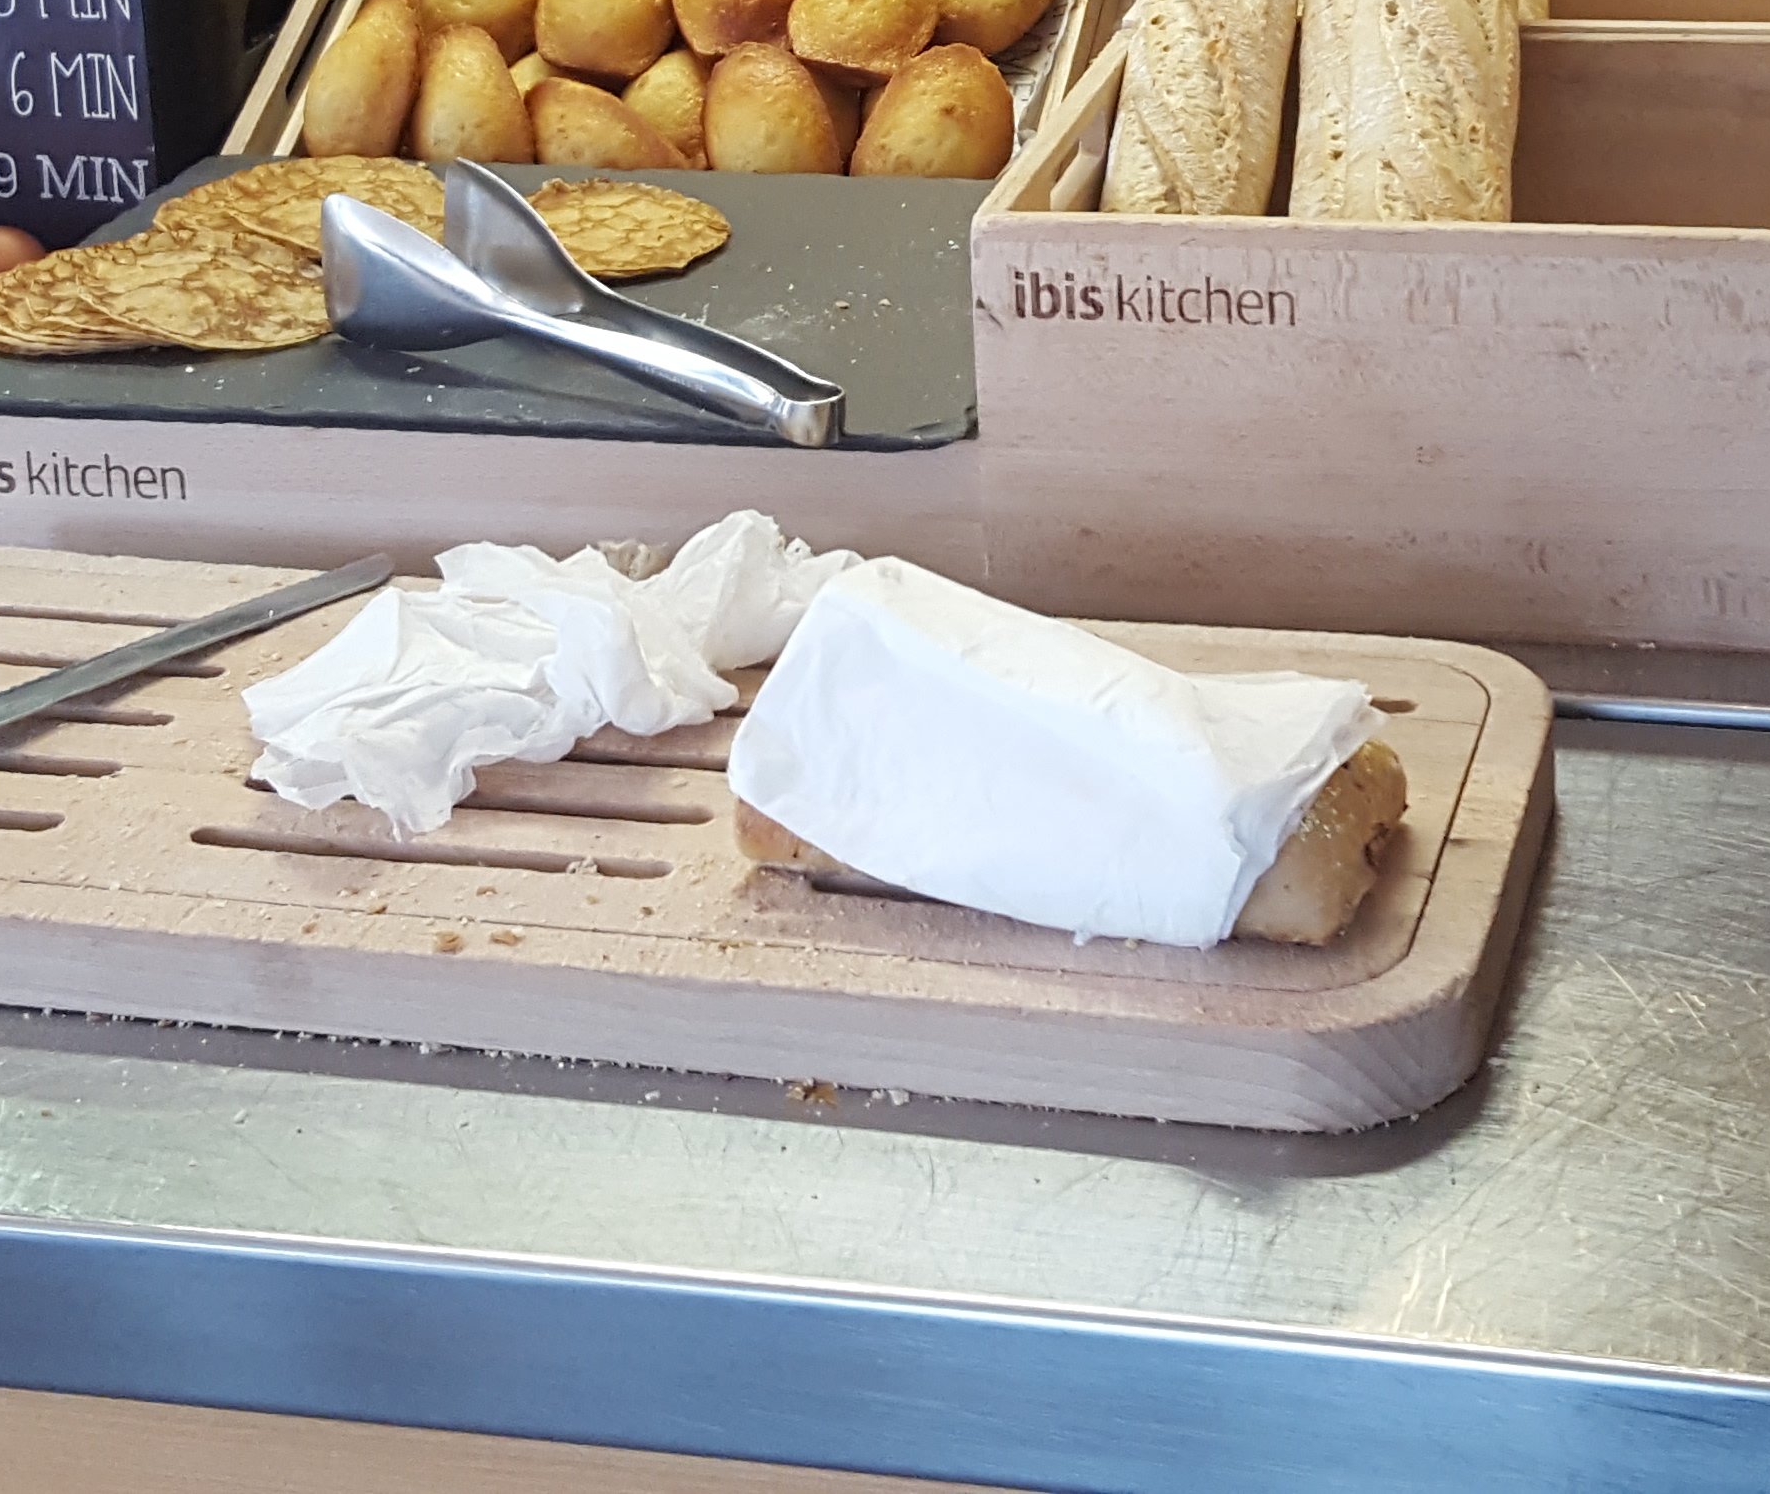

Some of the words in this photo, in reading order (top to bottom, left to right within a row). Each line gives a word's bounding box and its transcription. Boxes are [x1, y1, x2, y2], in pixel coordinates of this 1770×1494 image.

[10, 51, 34, 117] 6
[49, 52, 139, 121] MIN
[35, 154, 150, 204] MIN
[1013, 271, 1105, 321] ibis
[1116, 274, 1297, 326] kitchen
[26, 450, 187, 501] kitchen
